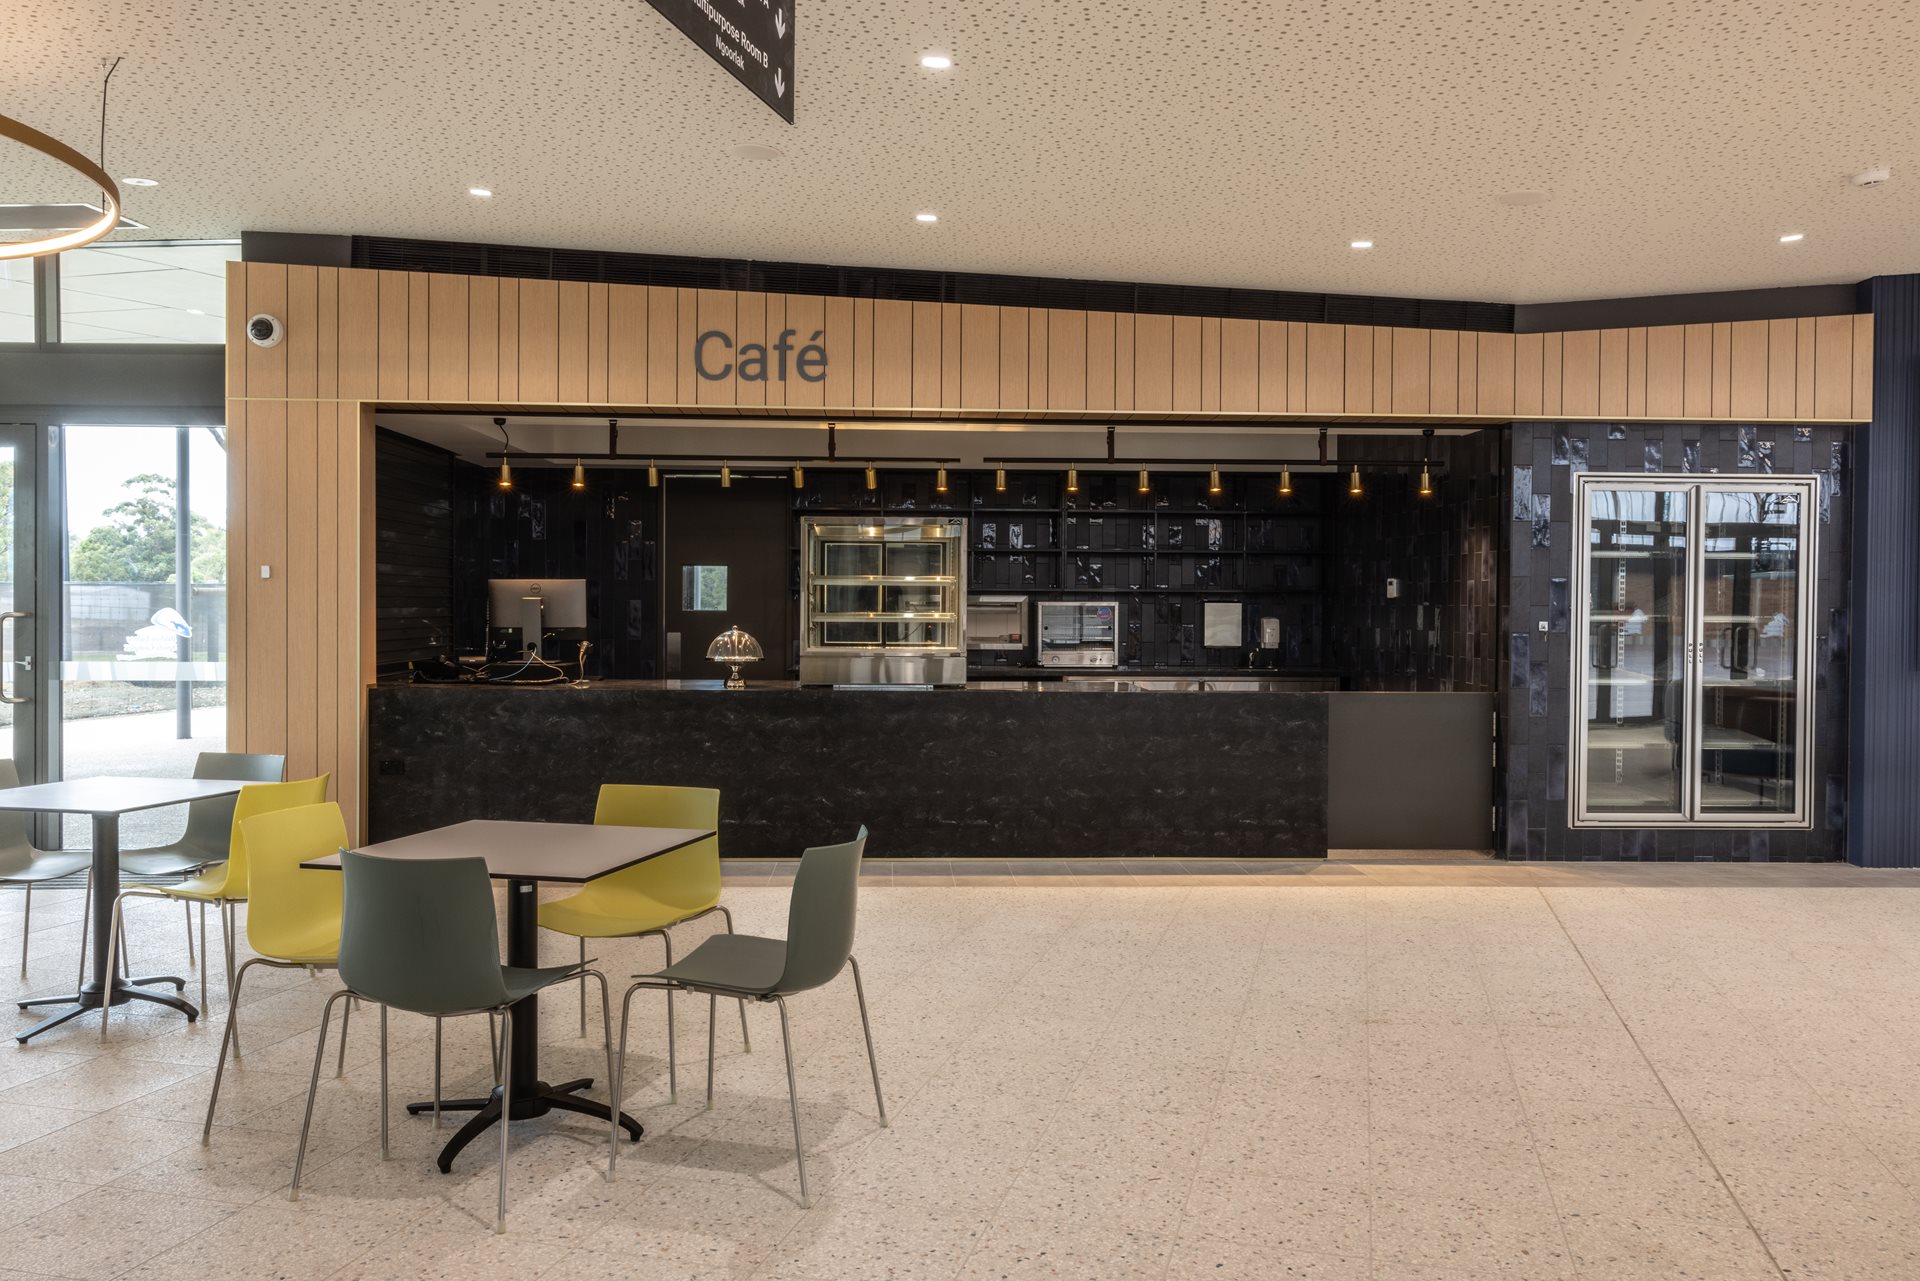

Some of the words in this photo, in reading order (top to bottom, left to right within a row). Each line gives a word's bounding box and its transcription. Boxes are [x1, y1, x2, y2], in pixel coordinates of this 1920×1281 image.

[694, 0, 740, 43] ultipurpose
[741, 31, 762, 63] Room
[763, 51, 768, 69] B
[715, 34, 745, 71] Ngoorlak
[695, 330, 828, 382] Café
